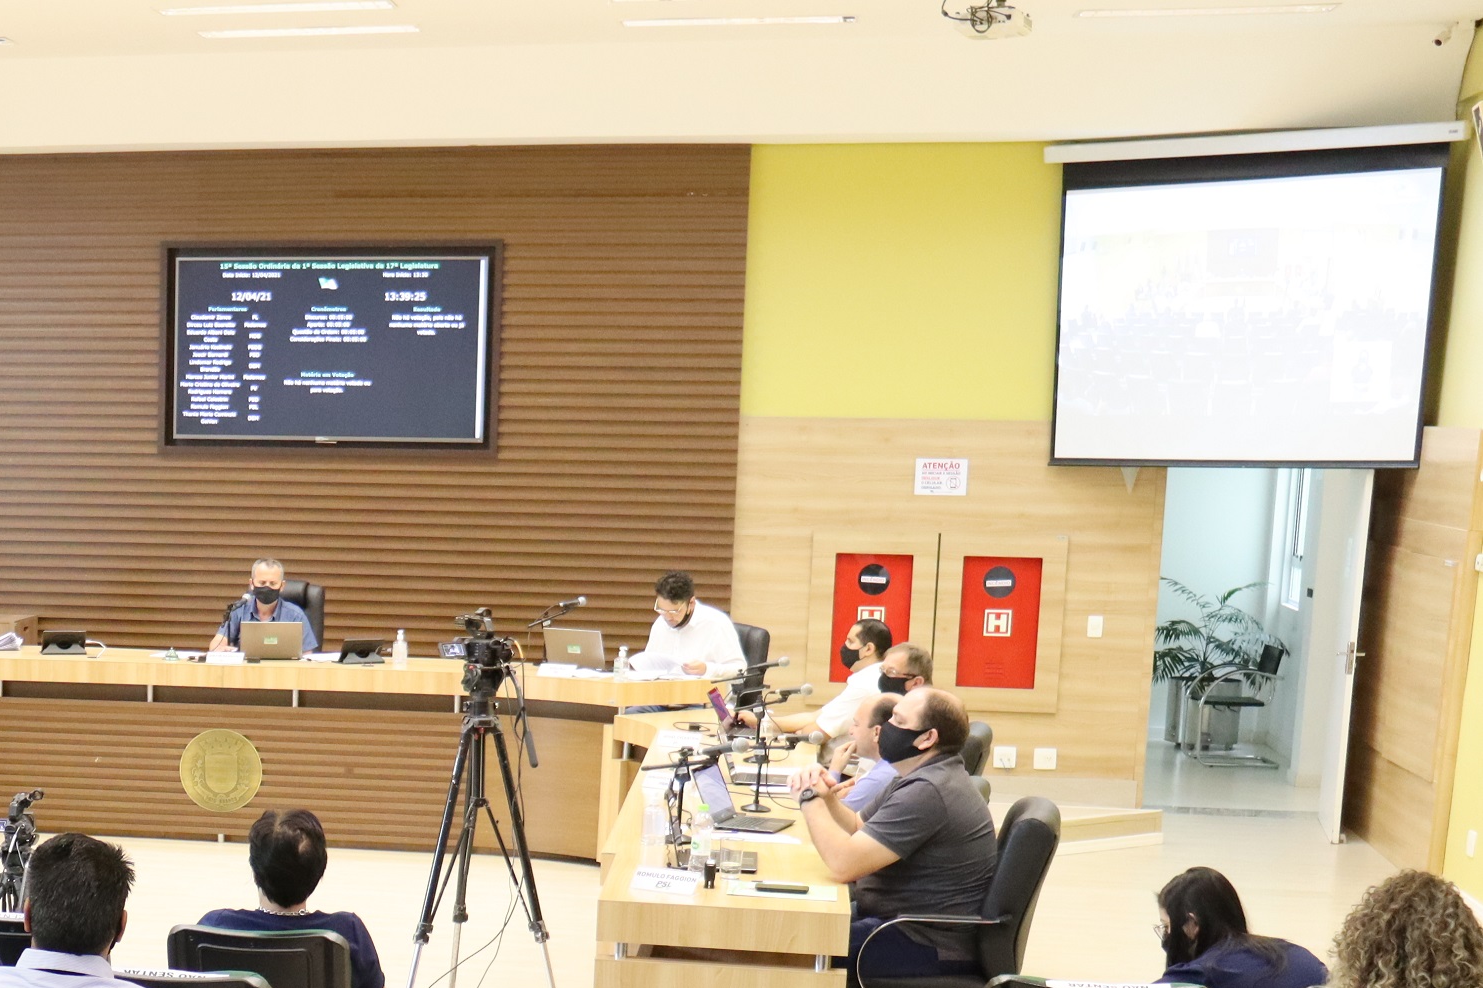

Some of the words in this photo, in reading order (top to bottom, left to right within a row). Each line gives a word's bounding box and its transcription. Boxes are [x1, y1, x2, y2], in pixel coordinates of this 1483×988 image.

[232, 292, 271, 302] 12/04/21
[385, 292, 426, 301] 13:39:25
[922, 461, 960, 470] ATENÇÃO
[988, 614, 1007, 632] H
[637, 870, 665, 878] ROMULO
